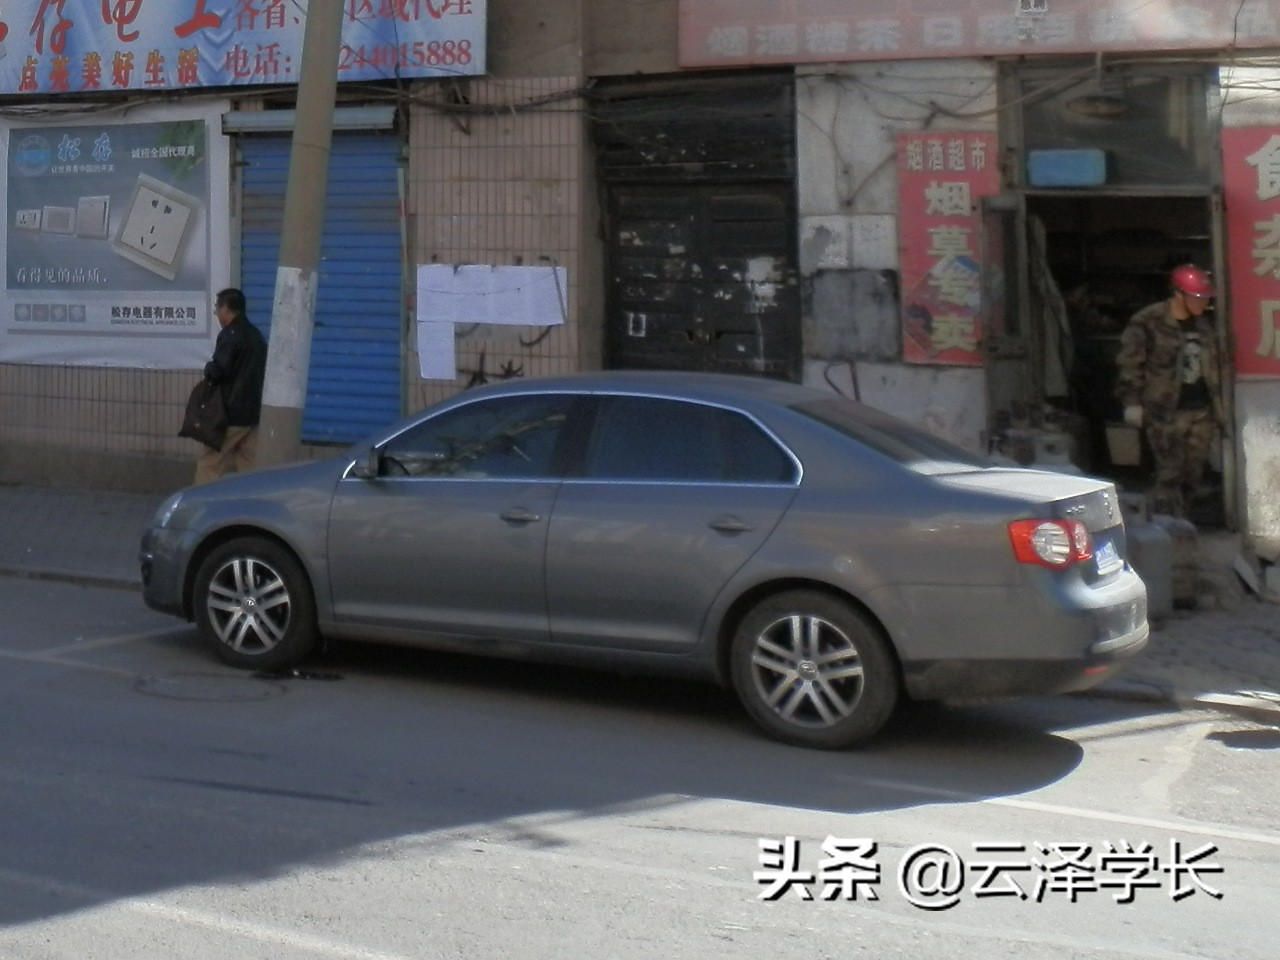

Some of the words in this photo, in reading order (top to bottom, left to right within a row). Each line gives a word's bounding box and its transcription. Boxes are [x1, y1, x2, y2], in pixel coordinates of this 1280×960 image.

[18, 47, 200, 92] 点亮美好生活
[924, 180, 980, 353] 烟草专卖
[111, 306, 196, 320] 松存电器有限公司
